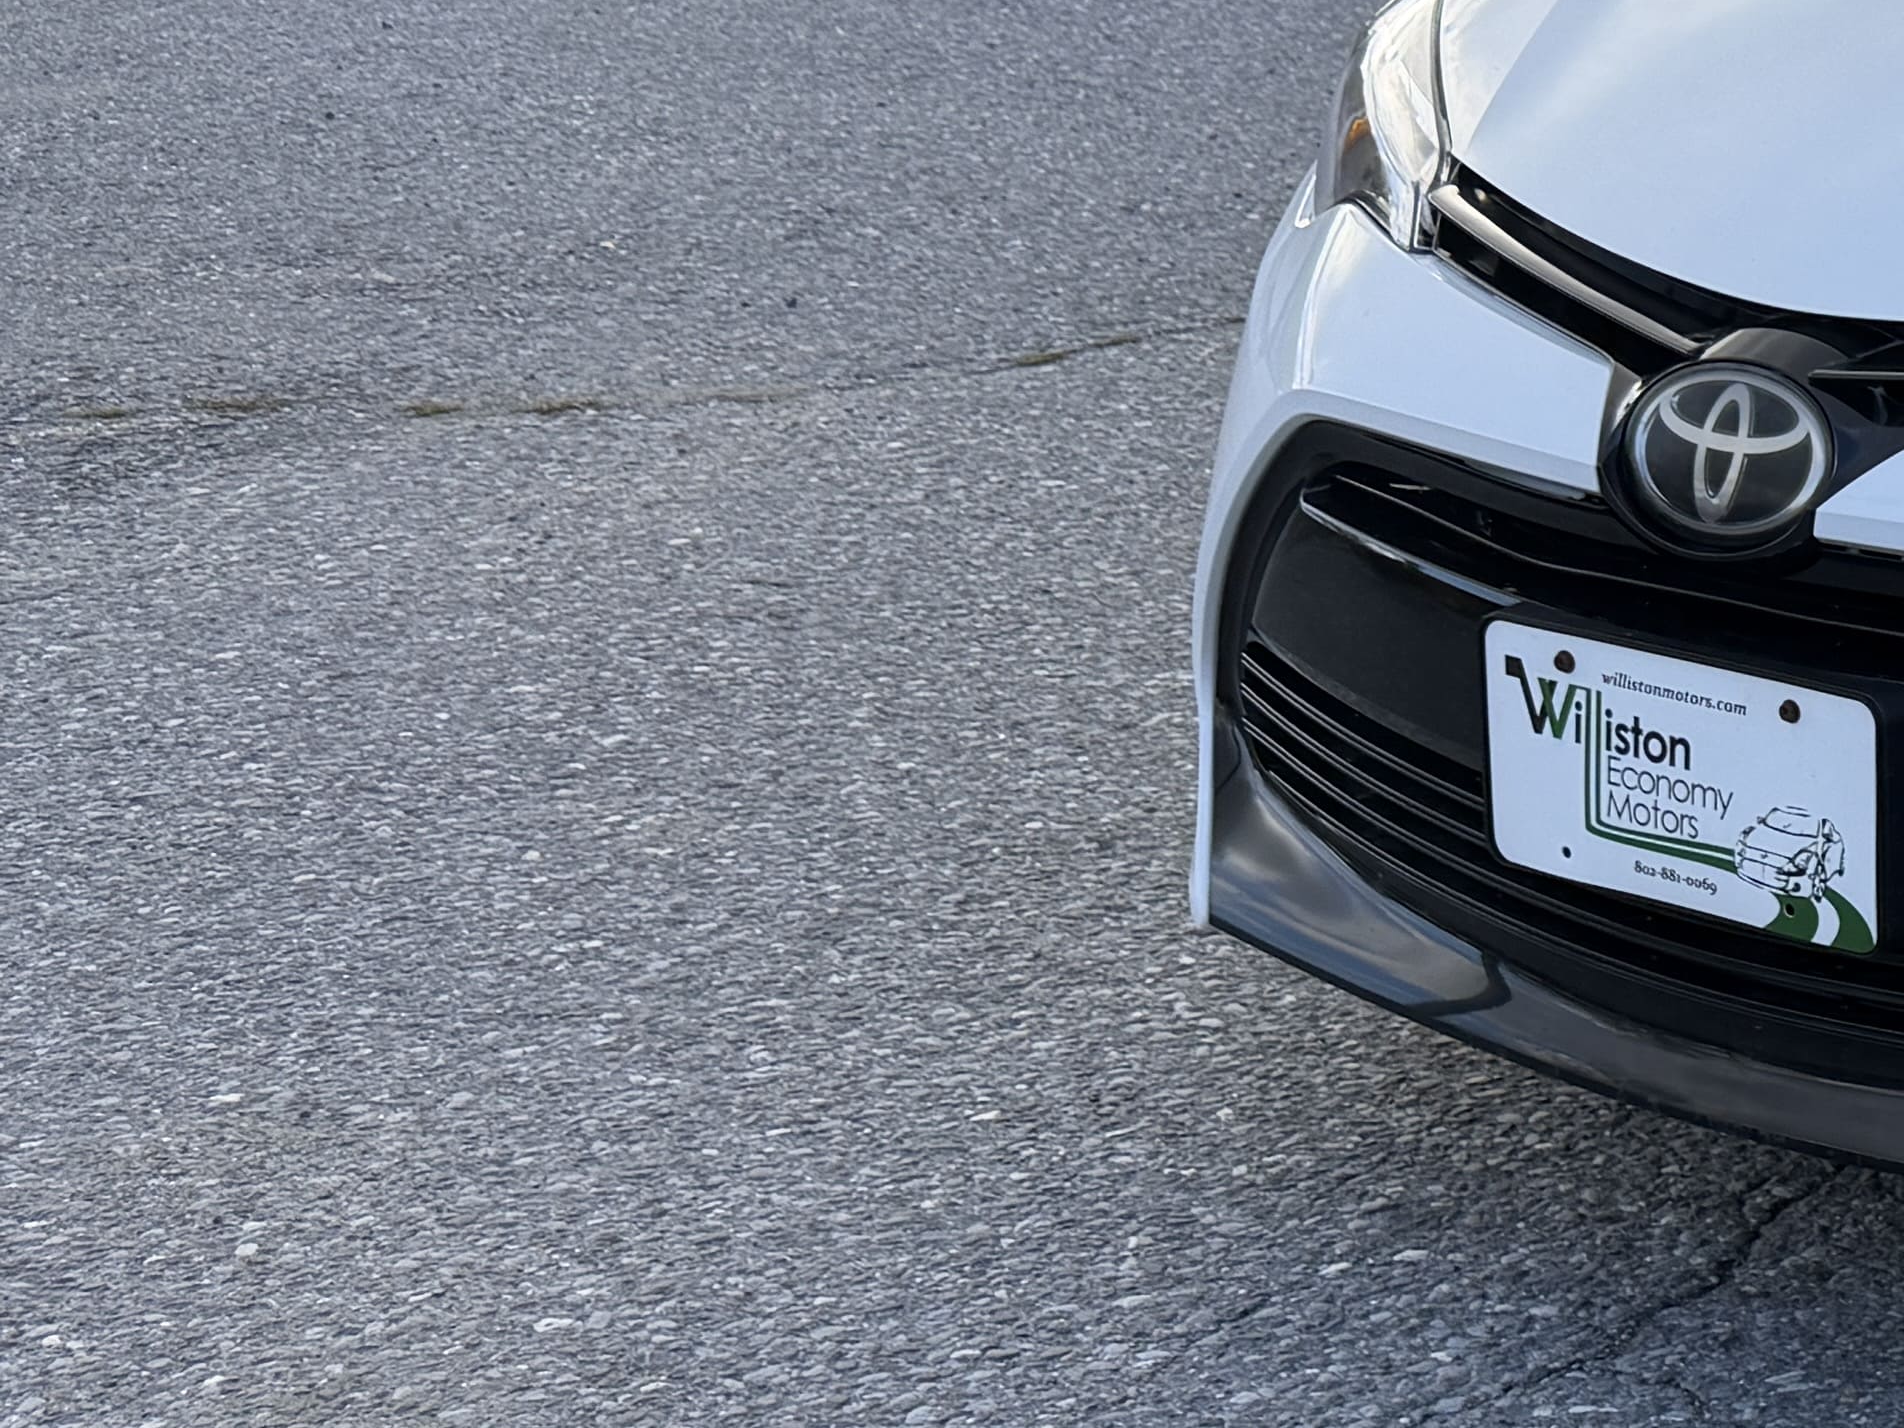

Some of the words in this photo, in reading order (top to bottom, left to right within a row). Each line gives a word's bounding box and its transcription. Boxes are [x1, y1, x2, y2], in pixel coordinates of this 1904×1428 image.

[1504, 654, 1692, 771] Williston
[1602, 671, 1747, 716] willistonmotors.com
[1607, 755, 1734, 821] Economy
[1607, 790, 1699, 839] Motors
